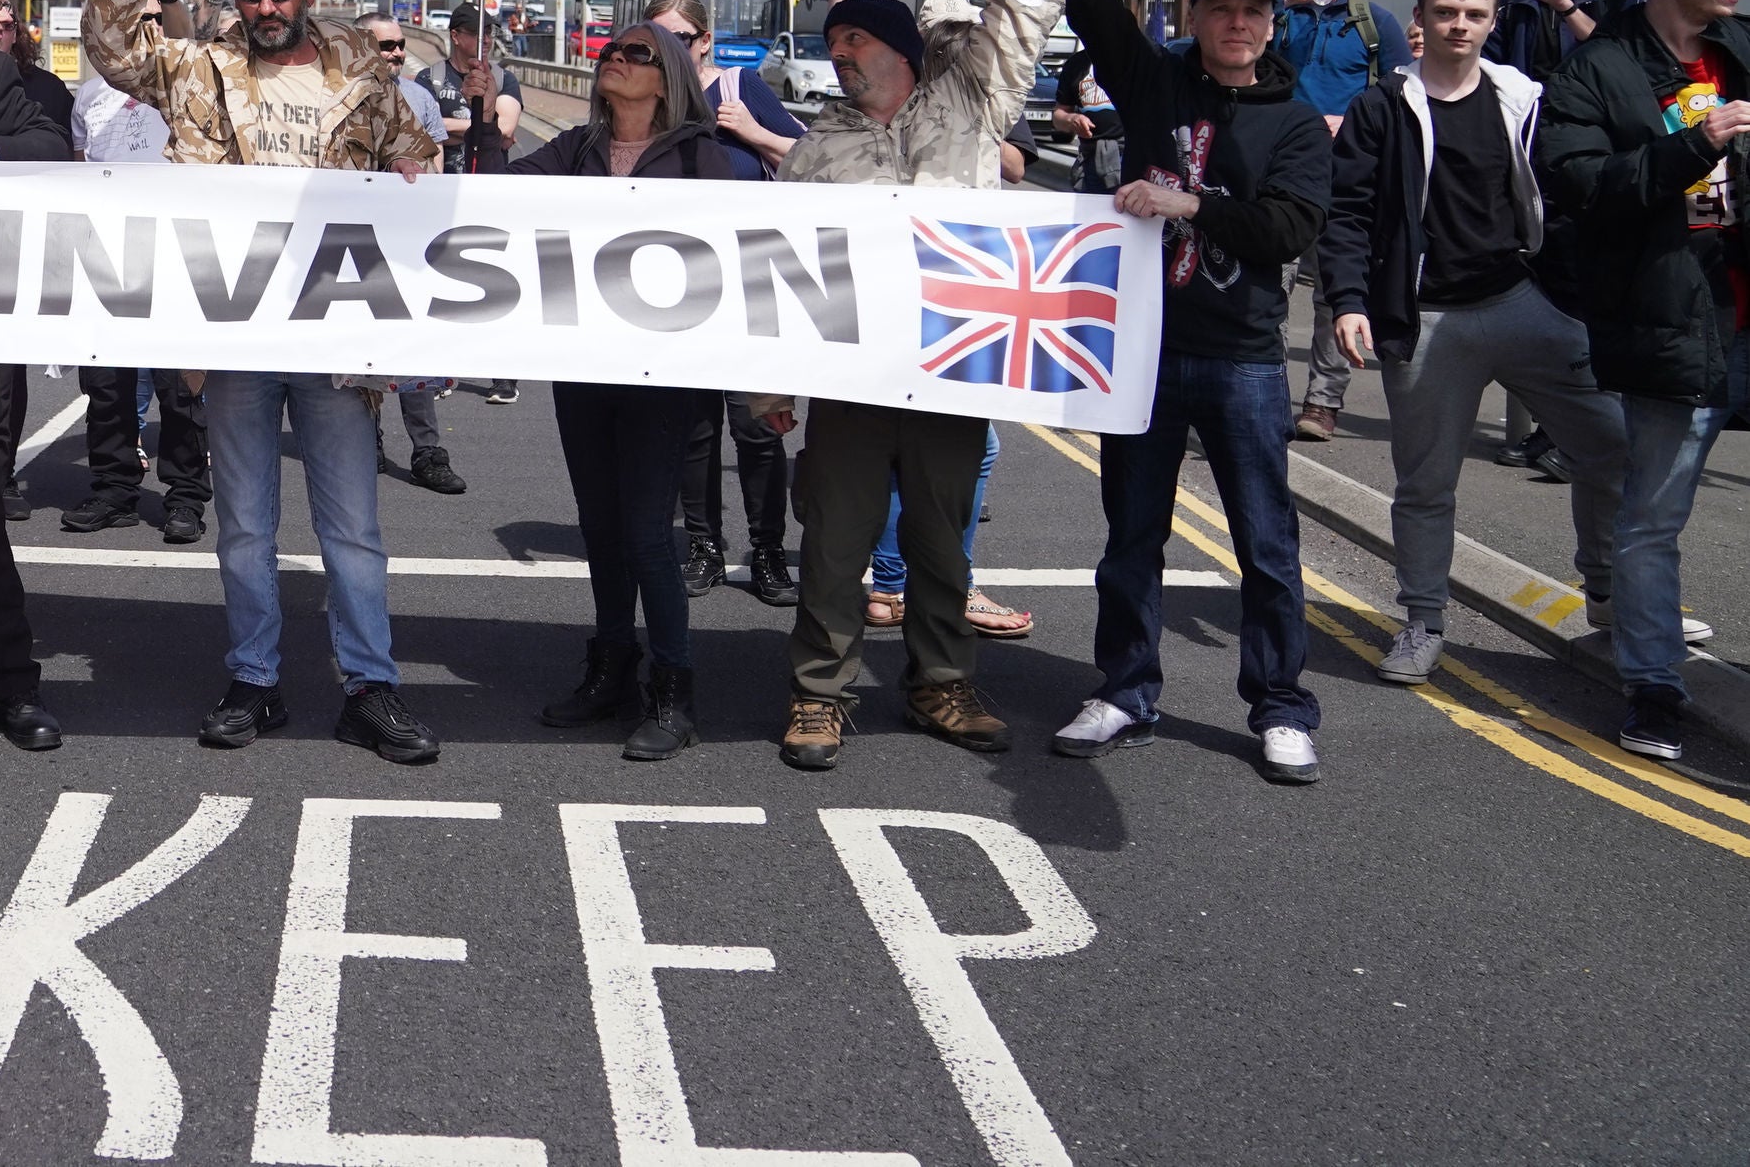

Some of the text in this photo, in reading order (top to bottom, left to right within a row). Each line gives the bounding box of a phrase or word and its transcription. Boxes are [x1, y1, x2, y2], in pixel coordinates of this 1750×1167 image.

[52, 42, 78, 53] FERRY
[52, 55, 78, 66] TICKETS
[257, 129, 290, 154] WAS
[1188, 124, 1210, 188] ACTIVE
